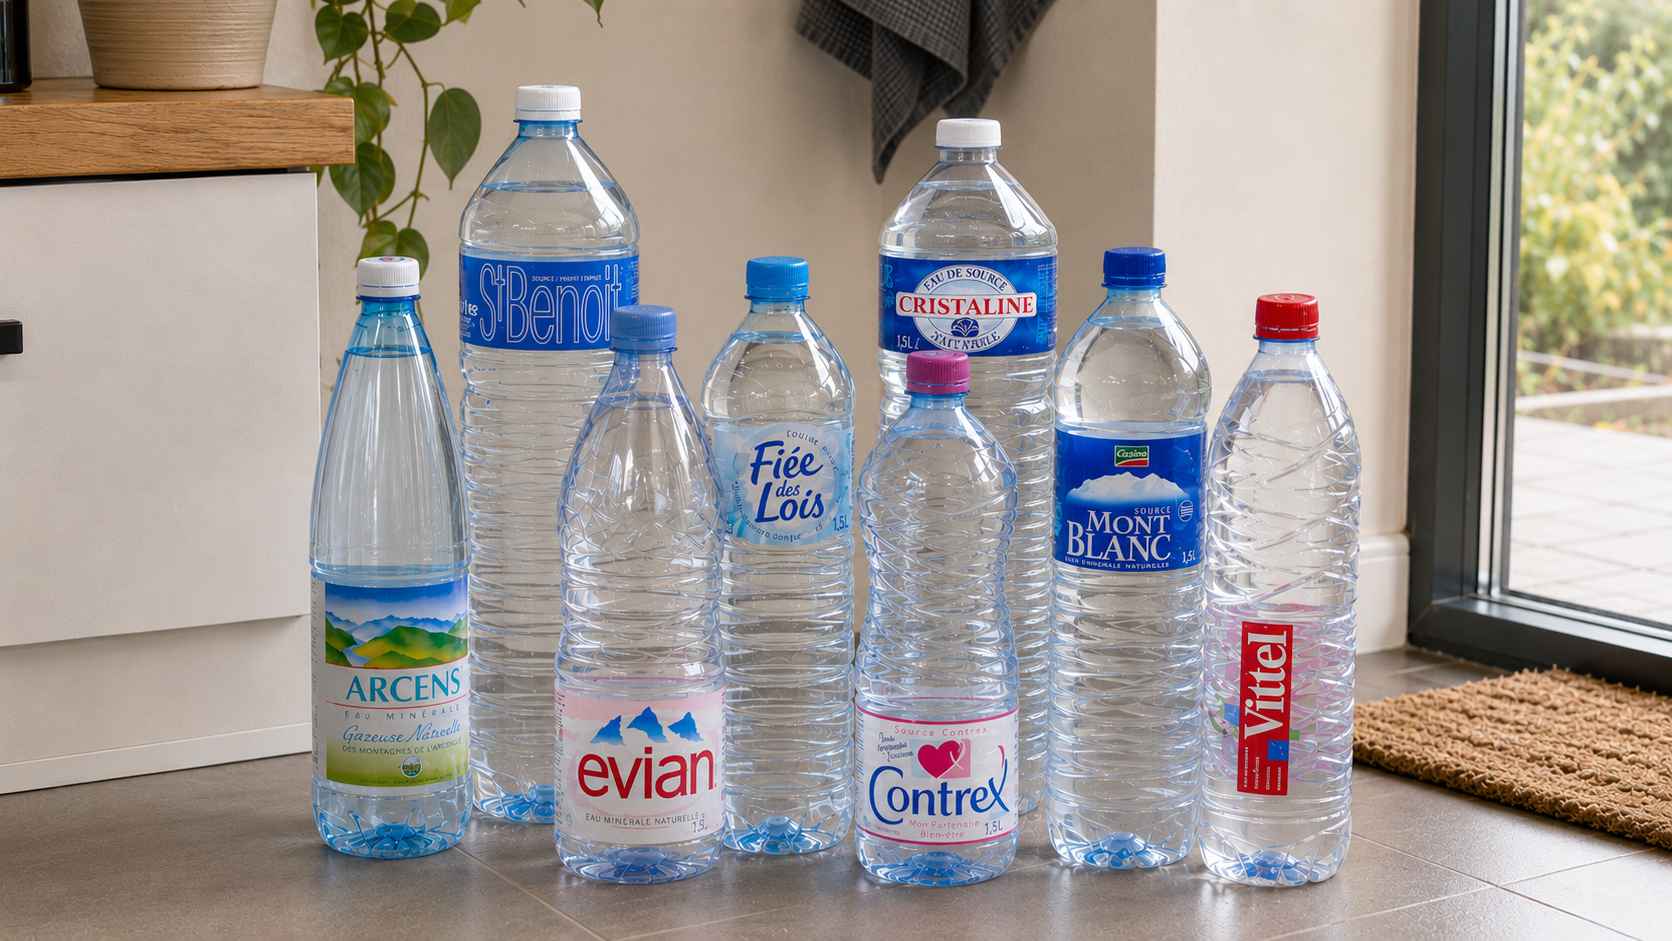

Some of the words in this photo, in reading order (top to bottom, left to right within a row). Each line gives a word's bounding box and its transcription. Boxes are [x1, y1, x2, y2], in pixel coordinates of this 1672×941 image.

[923, 272, 945, 291] EAU
[947, 268, 962, 279] DE
[965, 267, 1008, 291] SOURCE
[898, 295, 1034, 316] CRISTALINE
[750, 440, 824, 486] Fiée
[1116, 448, 1147, 458] Casino
[754, 481, 826, 523] Lois
[775, 479, 801, 498] des
[1086, 510, 1171, 535] MONT
[1134, 505, 1172, 515] SOURCE
[1066, 519, 1172, 562] BLANC
[345, 667, 461, 704] ARCENS
[1244, 630, 1288, 740] Vittel
[577, 746, 715, 800] evian
[869, 757, 1010, 826] Contrex
[585, 812, 601, 823] EAU
